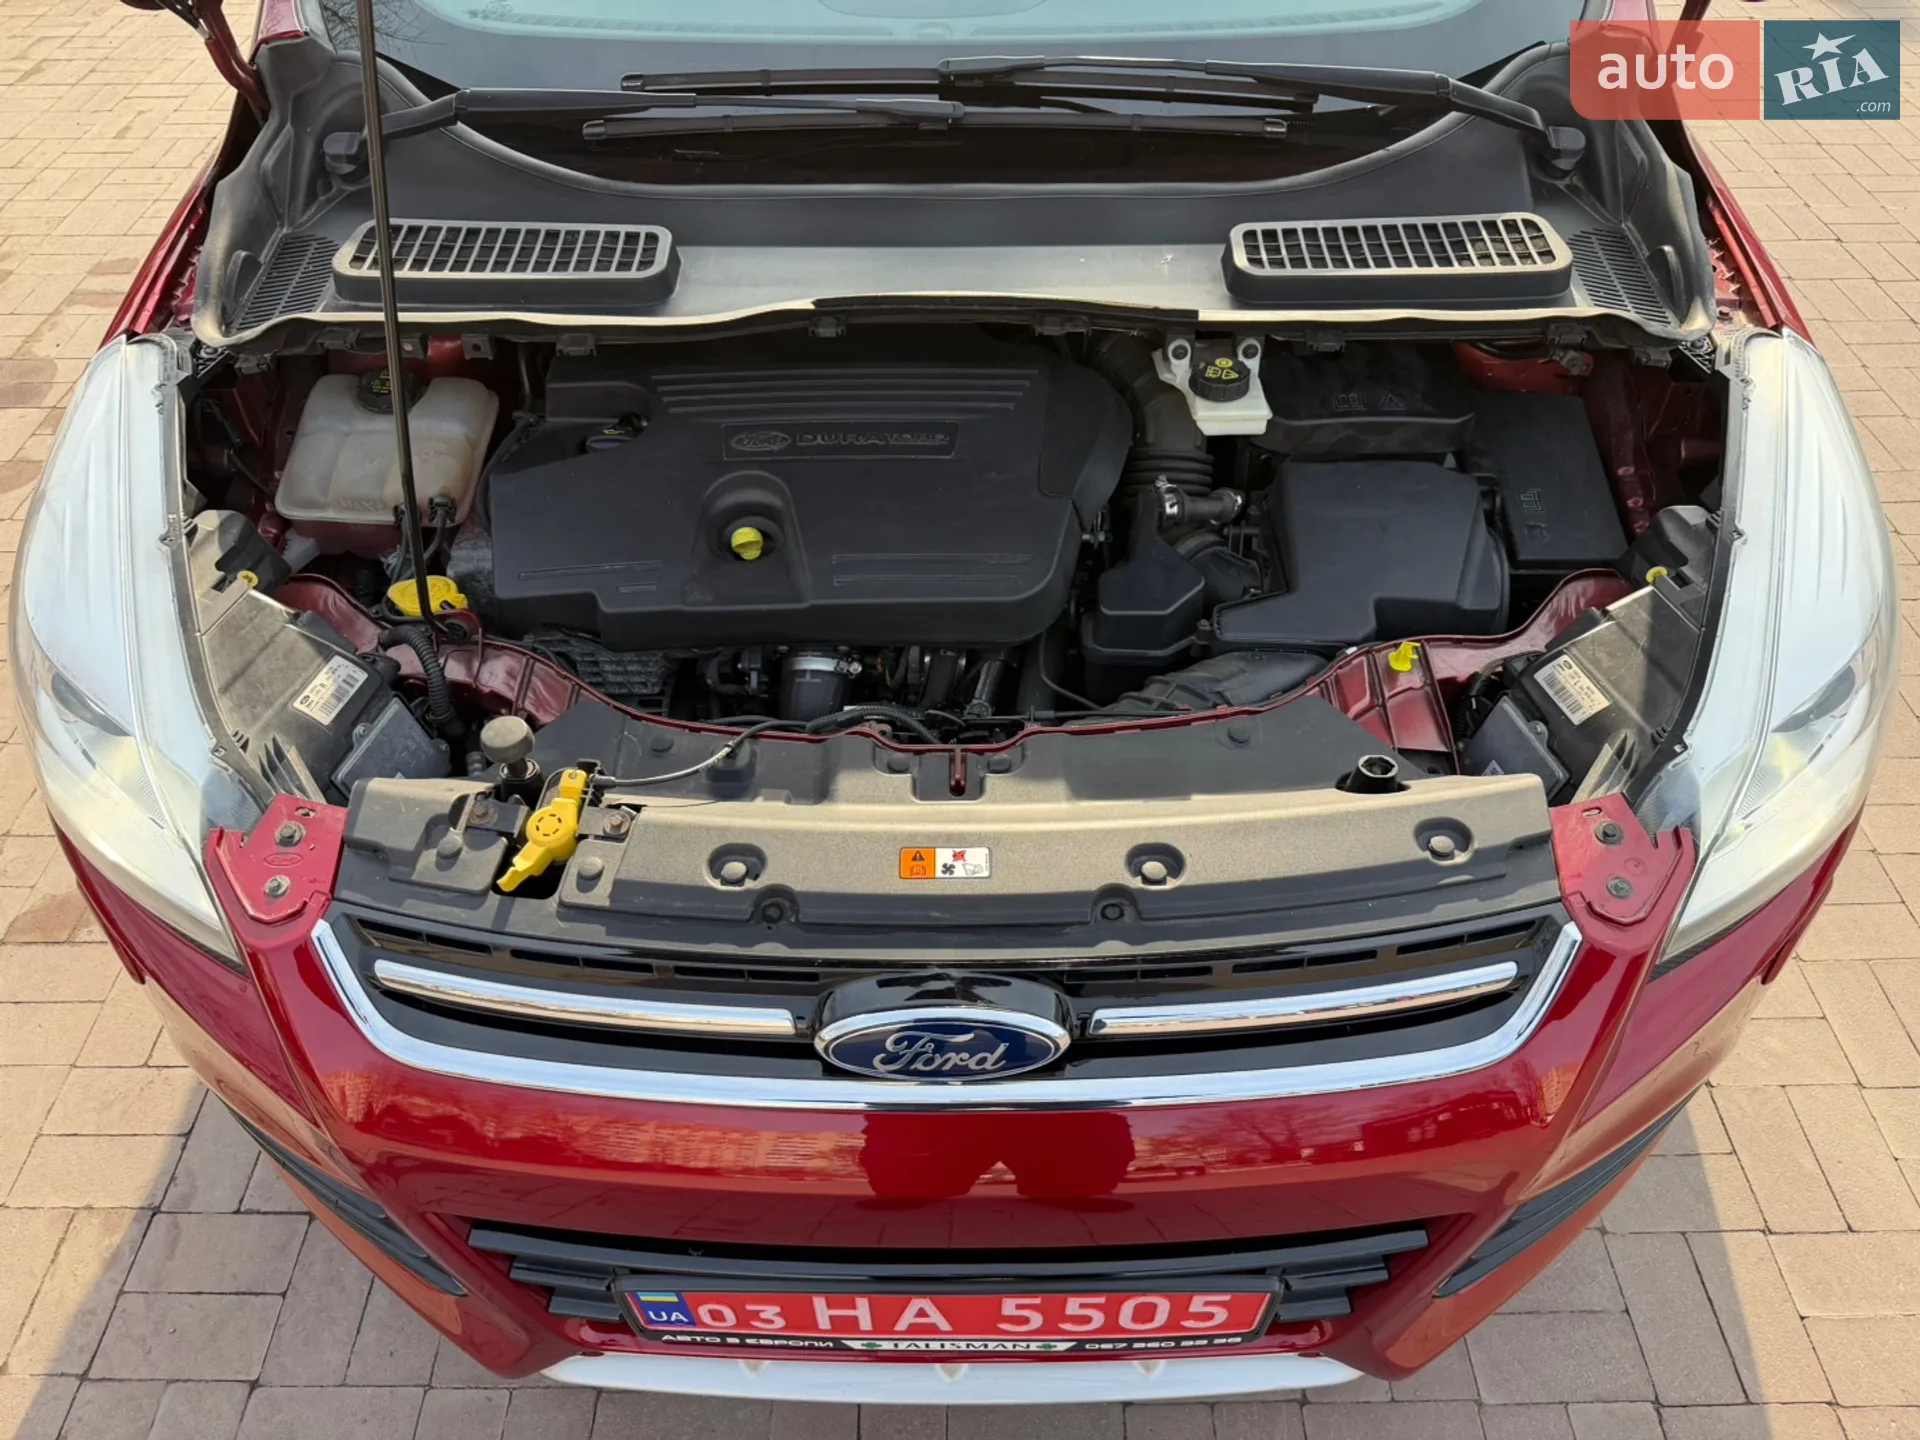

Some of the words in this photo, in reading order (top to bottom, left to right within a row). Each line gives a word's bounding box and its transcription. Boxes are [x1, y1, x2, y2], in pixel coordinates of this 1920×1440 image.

[872, 1030, 1010, 1073] Ford
[648, 1310, 690, 1323] UA
[697, 1303, 787, 1330] 03
[811, 1295, 953, 1332] HA
[996, 1294, 1232, 1332] 5505
